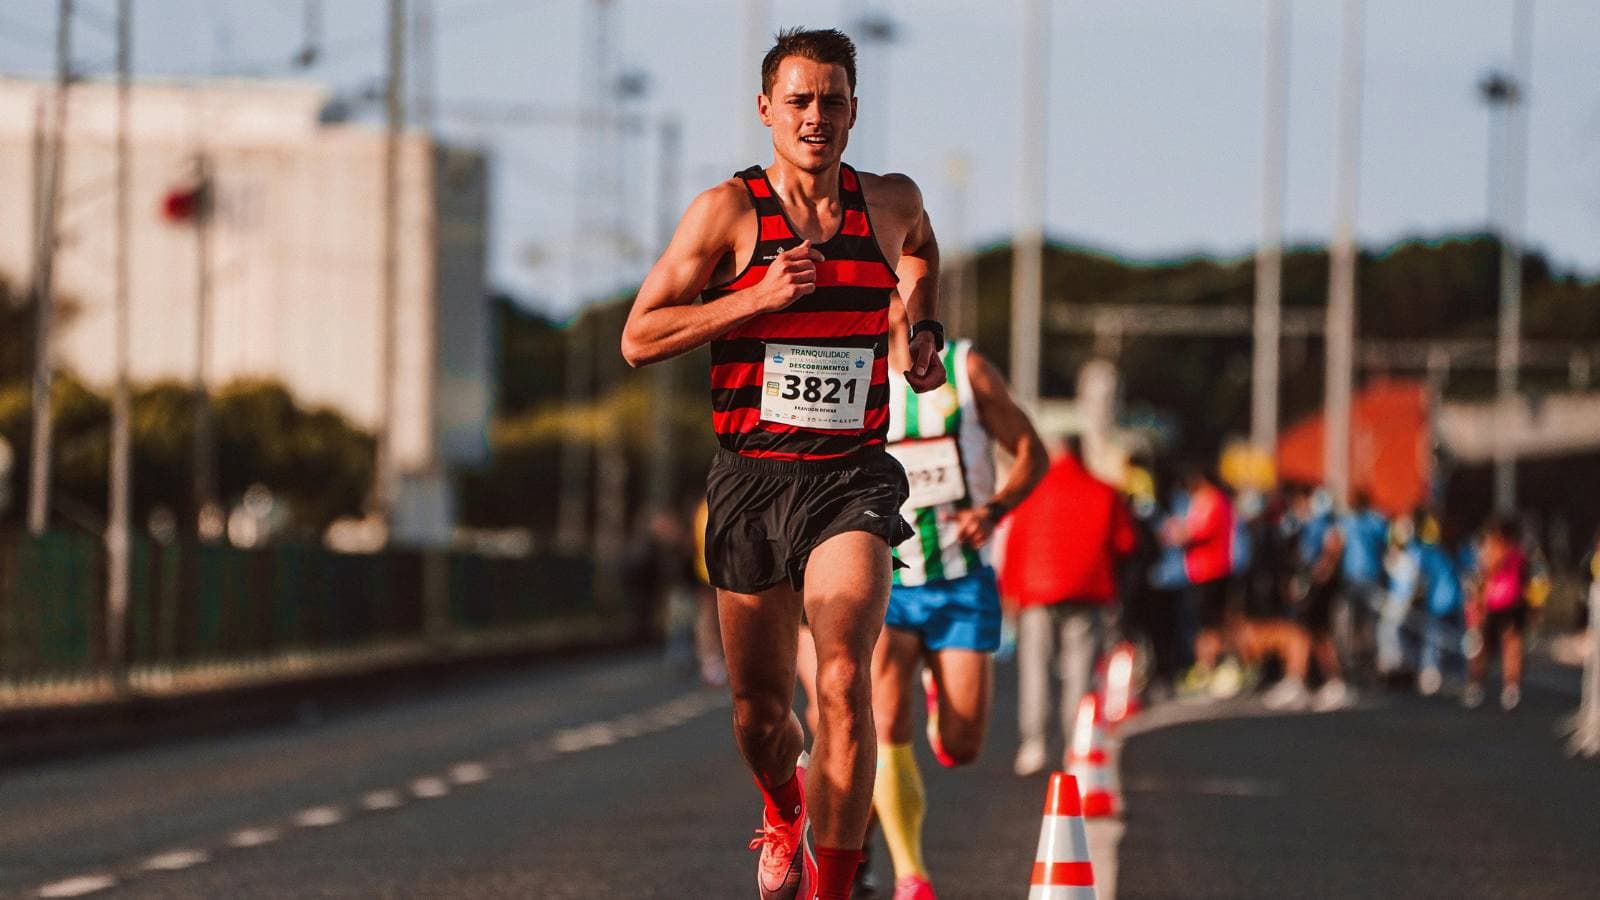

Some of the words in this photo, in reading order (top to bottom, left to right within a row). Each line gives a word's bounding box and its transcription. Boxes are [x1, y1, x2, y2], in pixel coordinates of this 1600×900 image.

[791, 349, 850, 358] TRANQUILIDADE
[789, 363, 849, 371] DESCOBRIMENTOS
[782, 375, 857, 404] 3821
